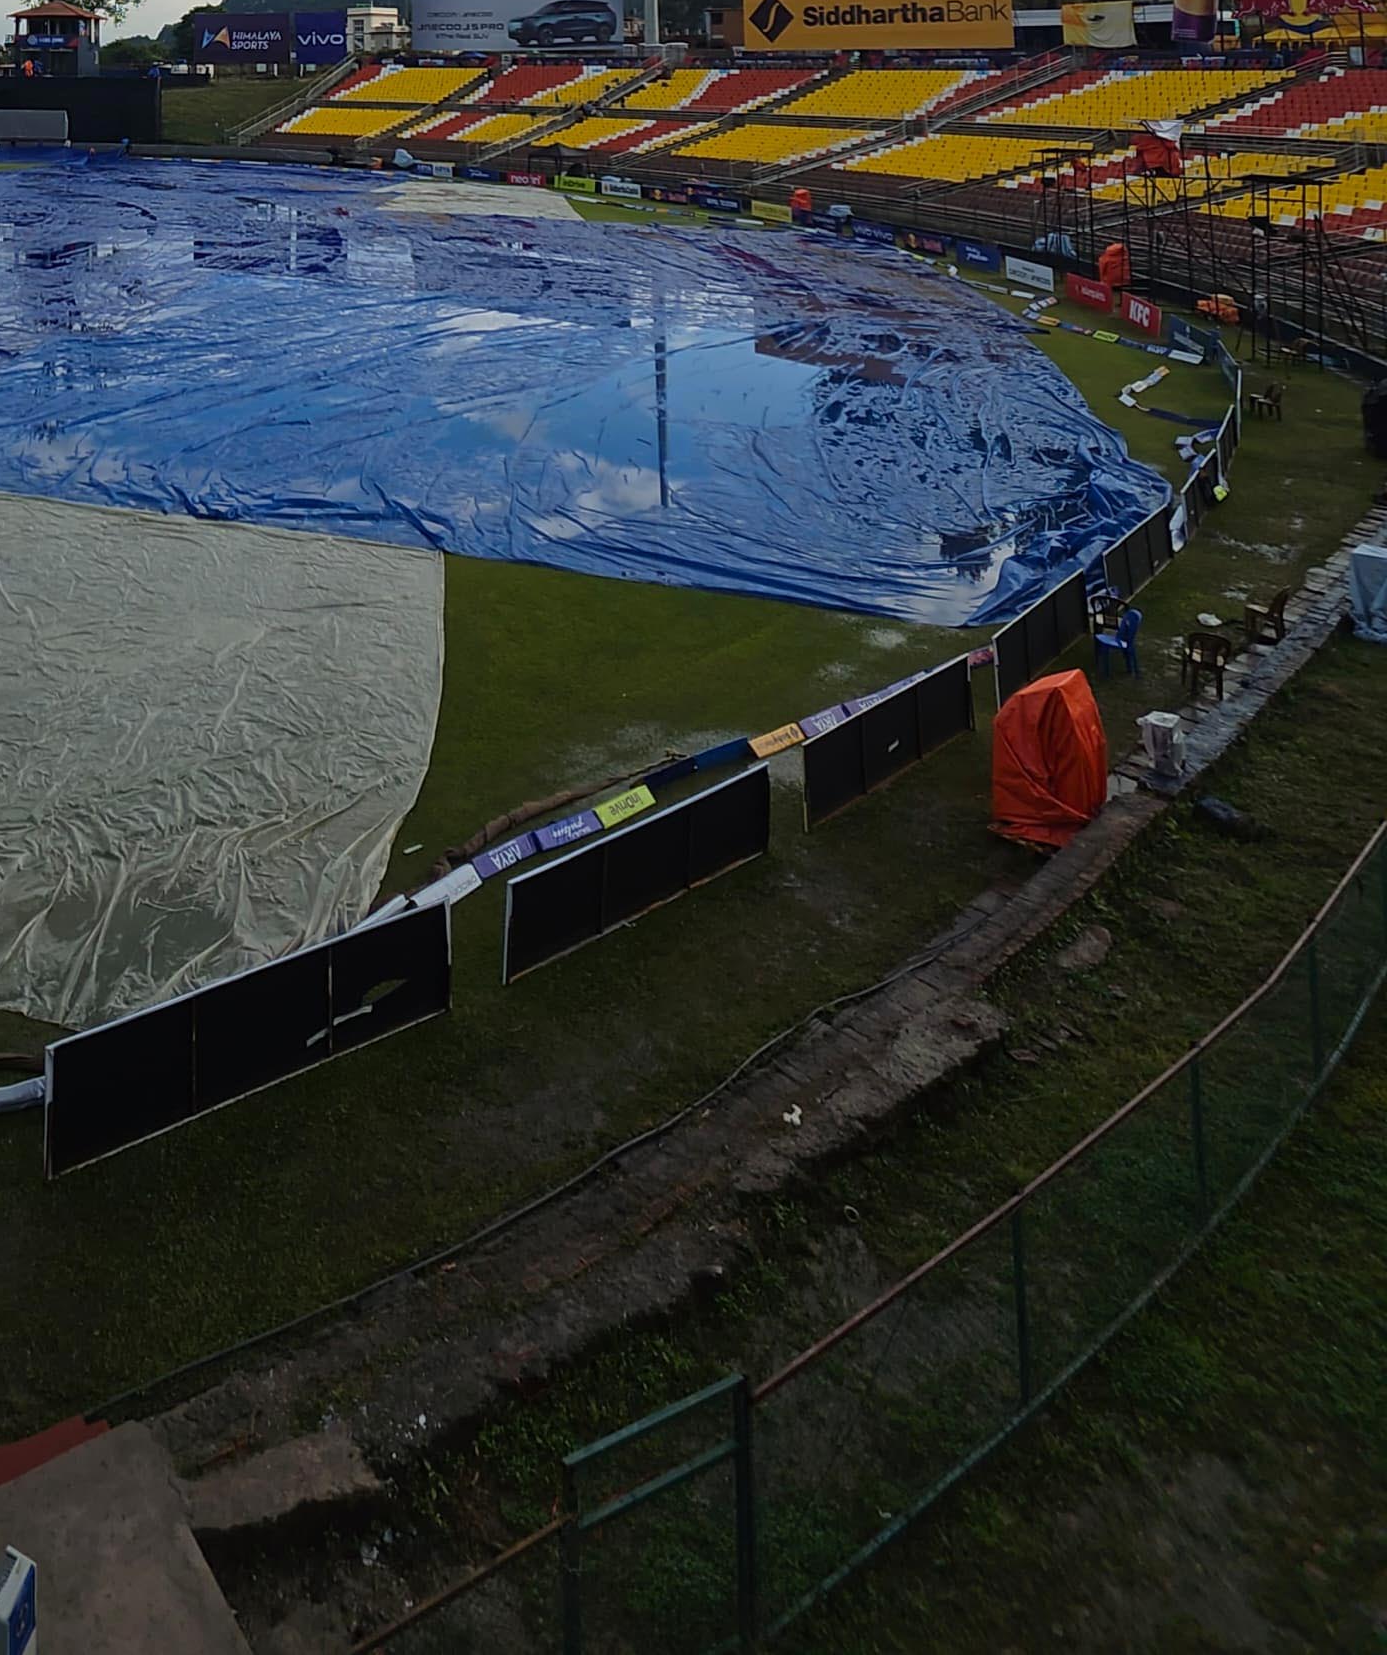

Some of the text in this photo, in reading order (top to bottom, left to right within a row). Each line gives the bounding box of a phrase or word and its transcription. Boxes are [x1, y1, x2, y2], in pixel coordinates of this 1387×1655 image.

[480, 23, 505, 31] PRO
[232, 31, 282, 41] HIMALAYA
[298, 31, 345, 46] vivo
[231, 41, 269, 50] SPORTS
[1129, 300, 1151, 328] KFC
[491, 841, 522, 869] ARYA
